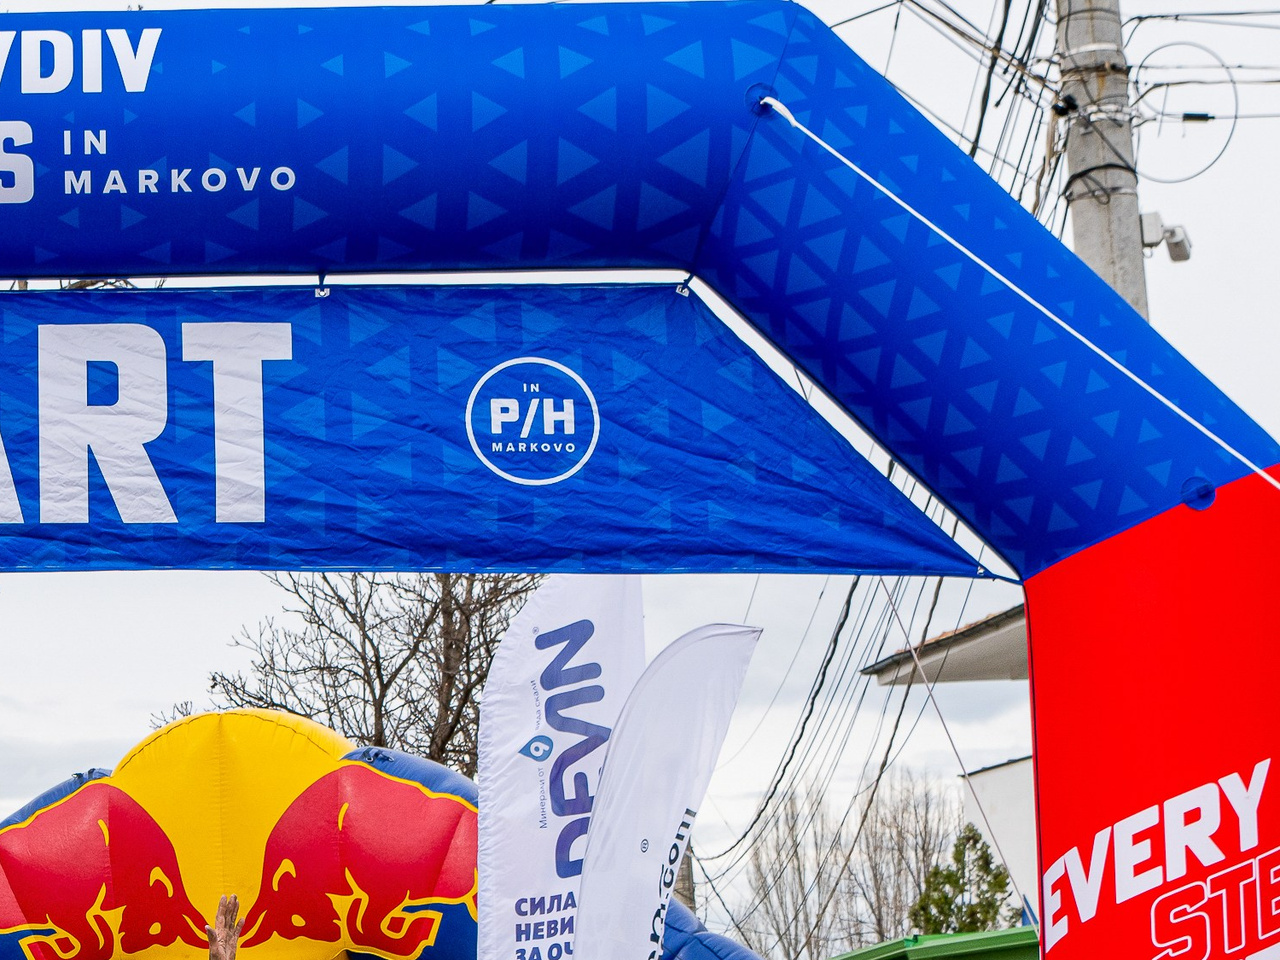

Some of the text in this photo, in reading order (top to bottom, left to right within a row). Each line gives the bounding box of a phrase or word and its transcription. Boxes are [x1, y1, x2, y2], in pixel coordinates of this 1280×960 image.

[64, 130, 108, 155] IN
[65, 166, 297, 195] MARKOVO
[523, 383, 539, 393] IN
[490, 398, 575, 438] P/H
[492, 442, 575, 452] MARKOVO
[530, 742, 550, 758] 9
[1043, 757, 1271, 953] EVERY
[514, 892, 577, 916] СИЛА
[515, 916, 574, 942] НЕВИ
